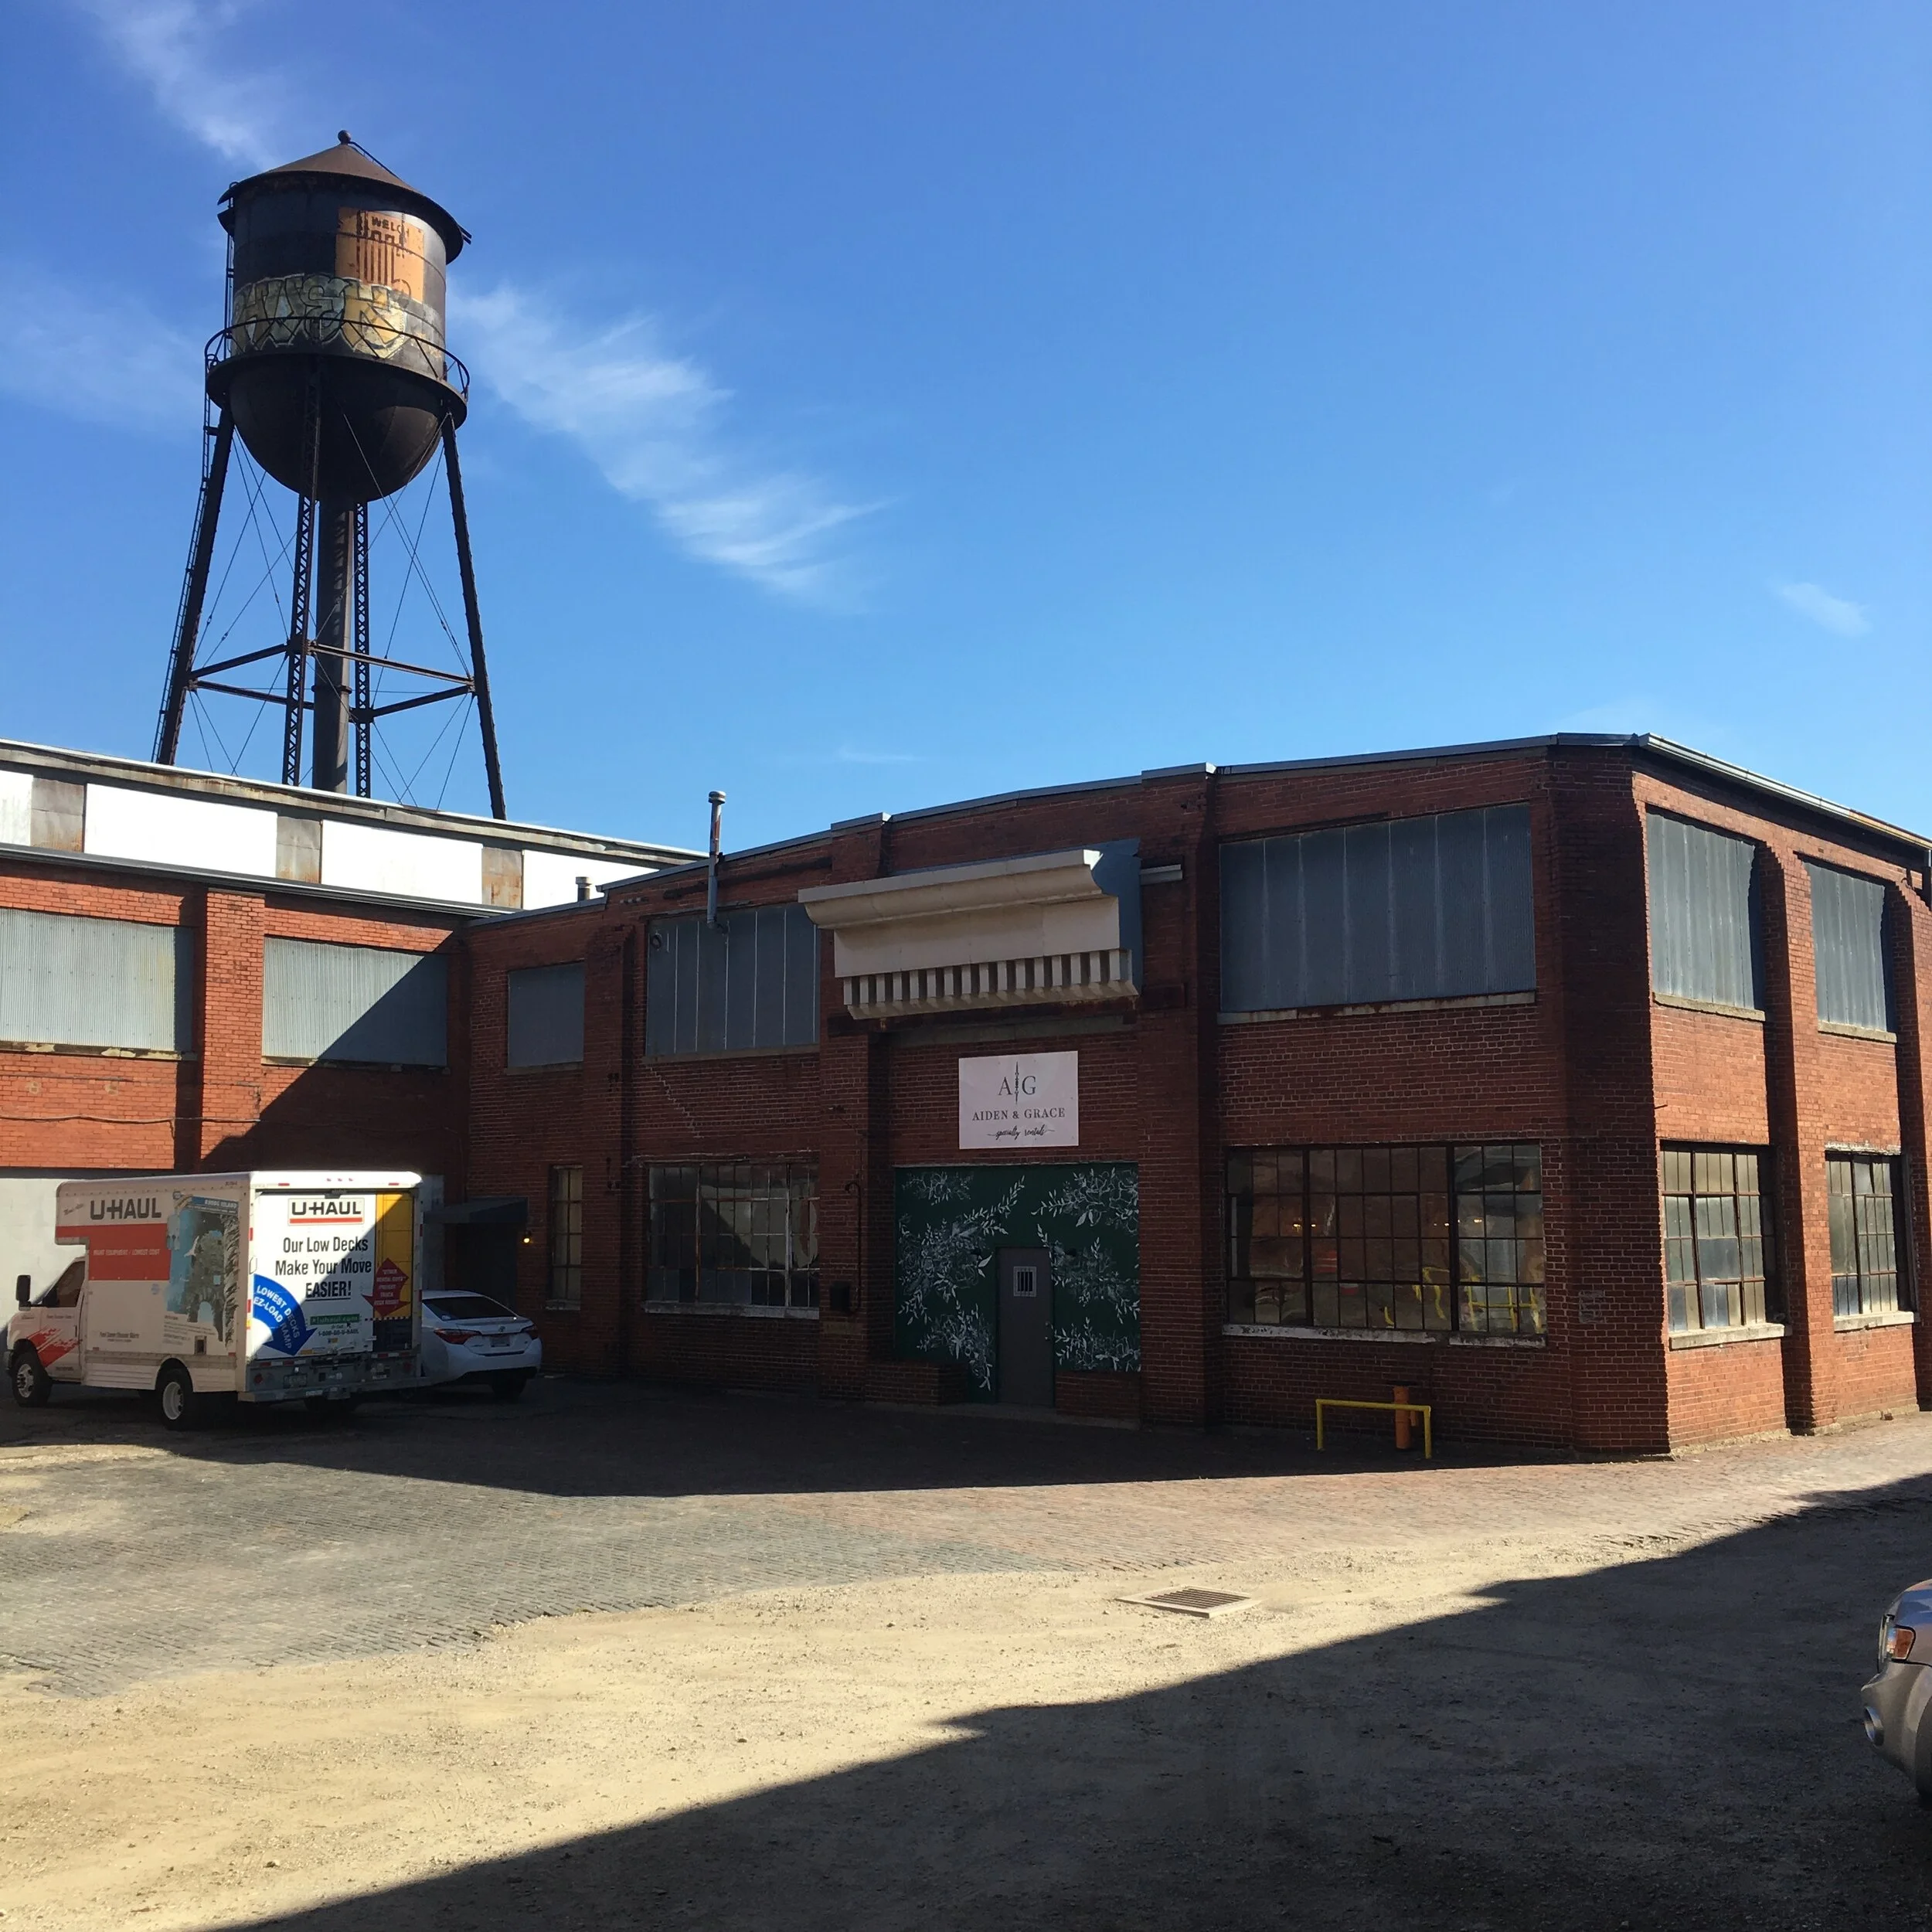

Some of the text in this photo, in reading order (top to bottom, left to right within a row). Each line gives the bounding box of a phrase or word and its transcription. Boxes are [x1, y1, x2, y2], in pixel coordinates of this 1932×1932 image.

[971, 1107, 1066, 1121] AIDEN & GRACE
[90, 1197, 162, 1220] U-HAUL
[291, 1201, 362, 1216] U-HAUL
[283, 1236, 369, 1253] Our Low Decks
[275, 1258, 372, 1276] Make Your Move
[305, 1281, 352, 1298] EASIER!
[256, 1284, 301, 1338] LOWEST DECKS
[253, 1296, 292, 1349] EZ-LOAD RAMP
